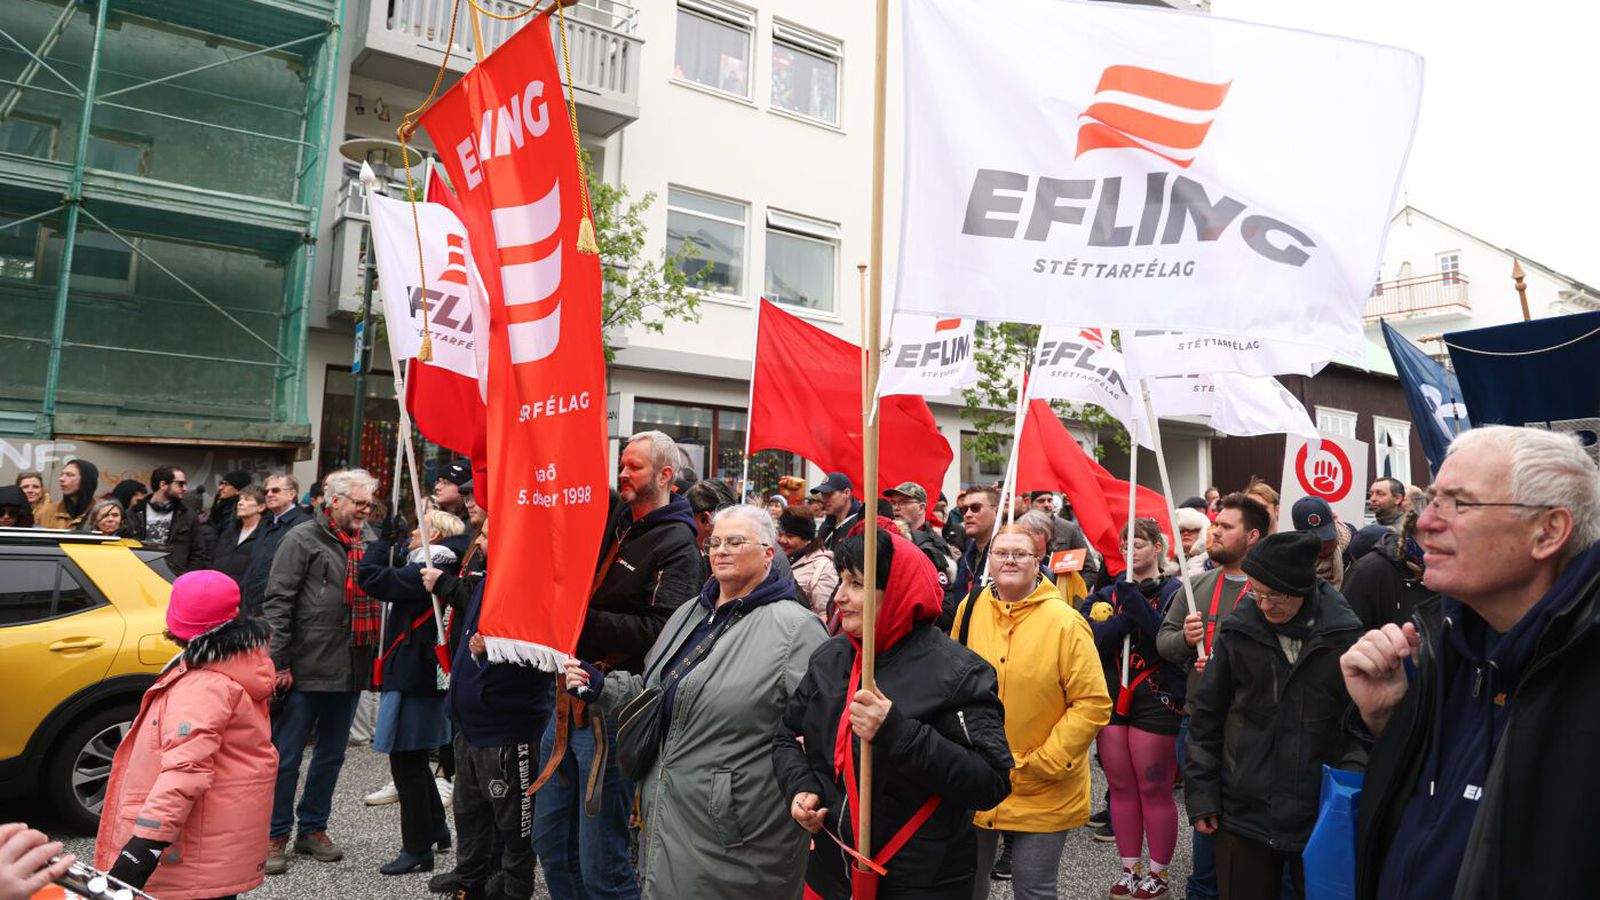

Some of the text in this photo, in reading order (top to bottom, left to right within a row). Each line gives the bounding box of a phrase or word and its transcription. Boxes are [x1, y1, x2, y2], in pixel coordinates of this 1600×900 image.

[961, 168, 1317, 268] EFLING
[1033, 258, 1195, 279] STÉTTARFÉLAG
[517, 489, 530, 505] 5.
[562, 485, 592, 505] 1998
